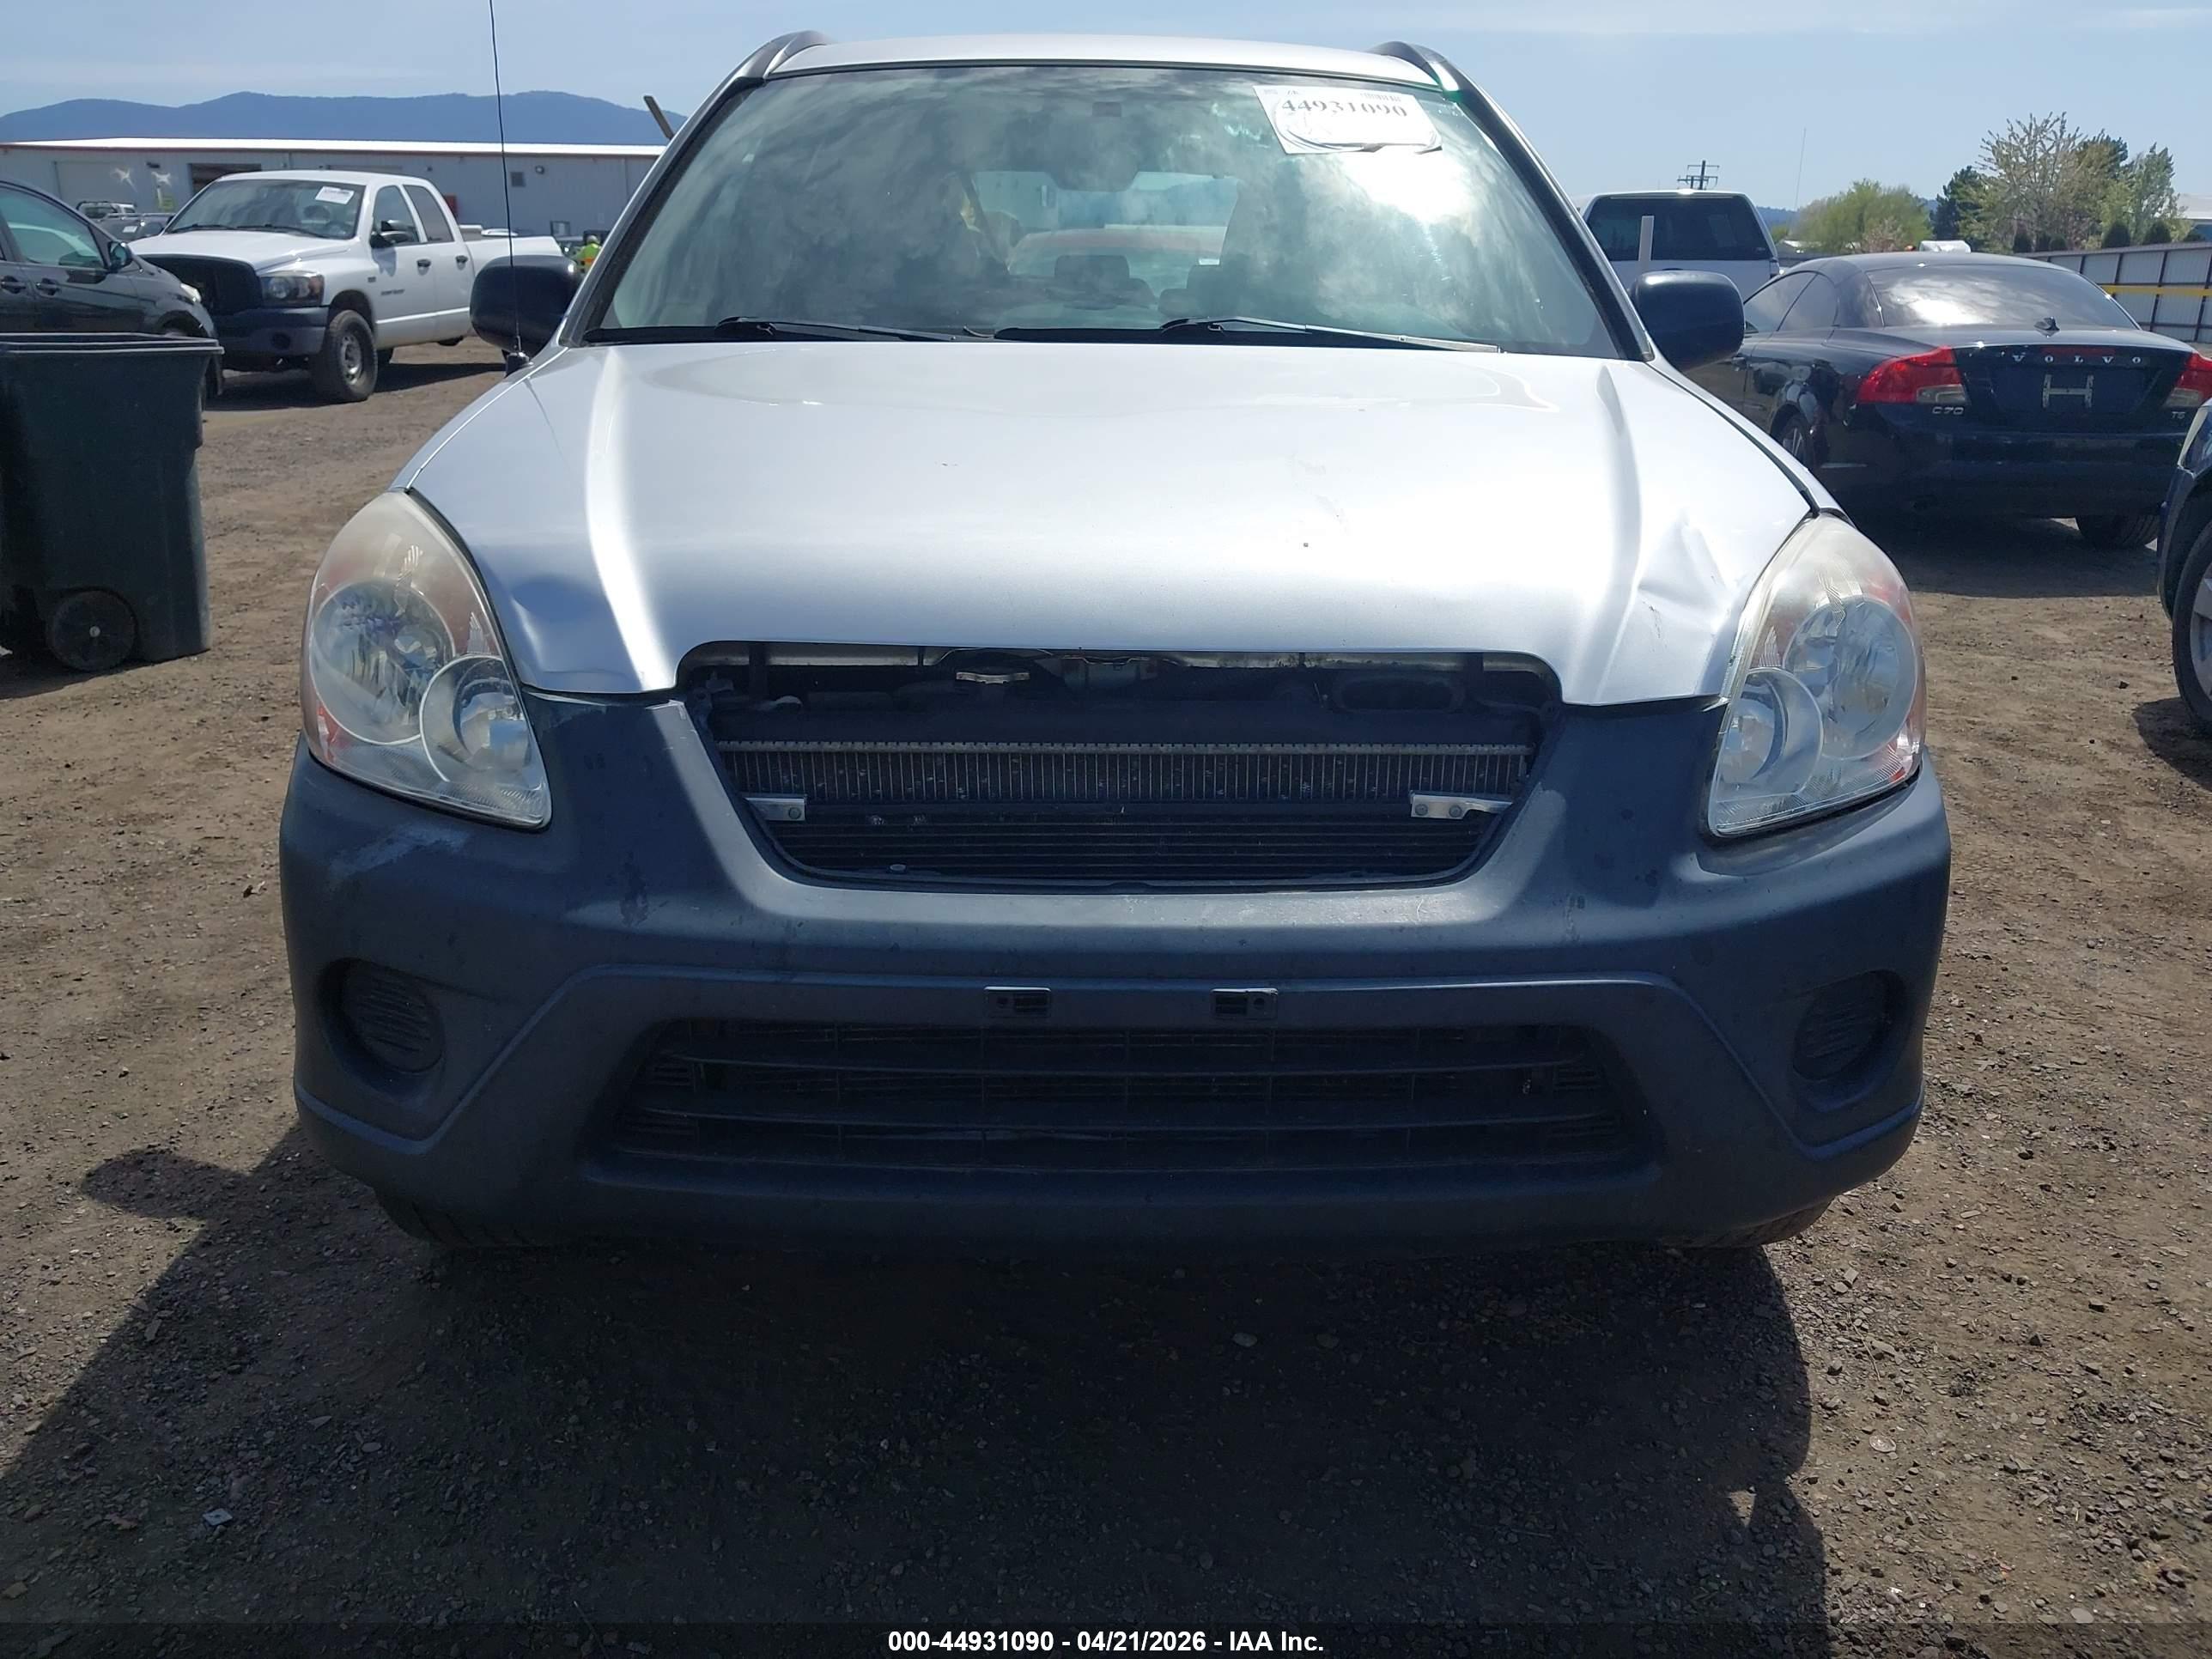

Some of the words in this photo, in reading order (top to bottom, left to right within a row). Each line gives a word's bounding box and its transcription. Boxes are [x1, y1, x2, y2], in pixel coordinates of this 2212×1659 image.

[1281, 98, 1409, 118] 44931090
[2012, 354, 2142, 365] VOLVO
[1931, 405, 1965, 416] C70
